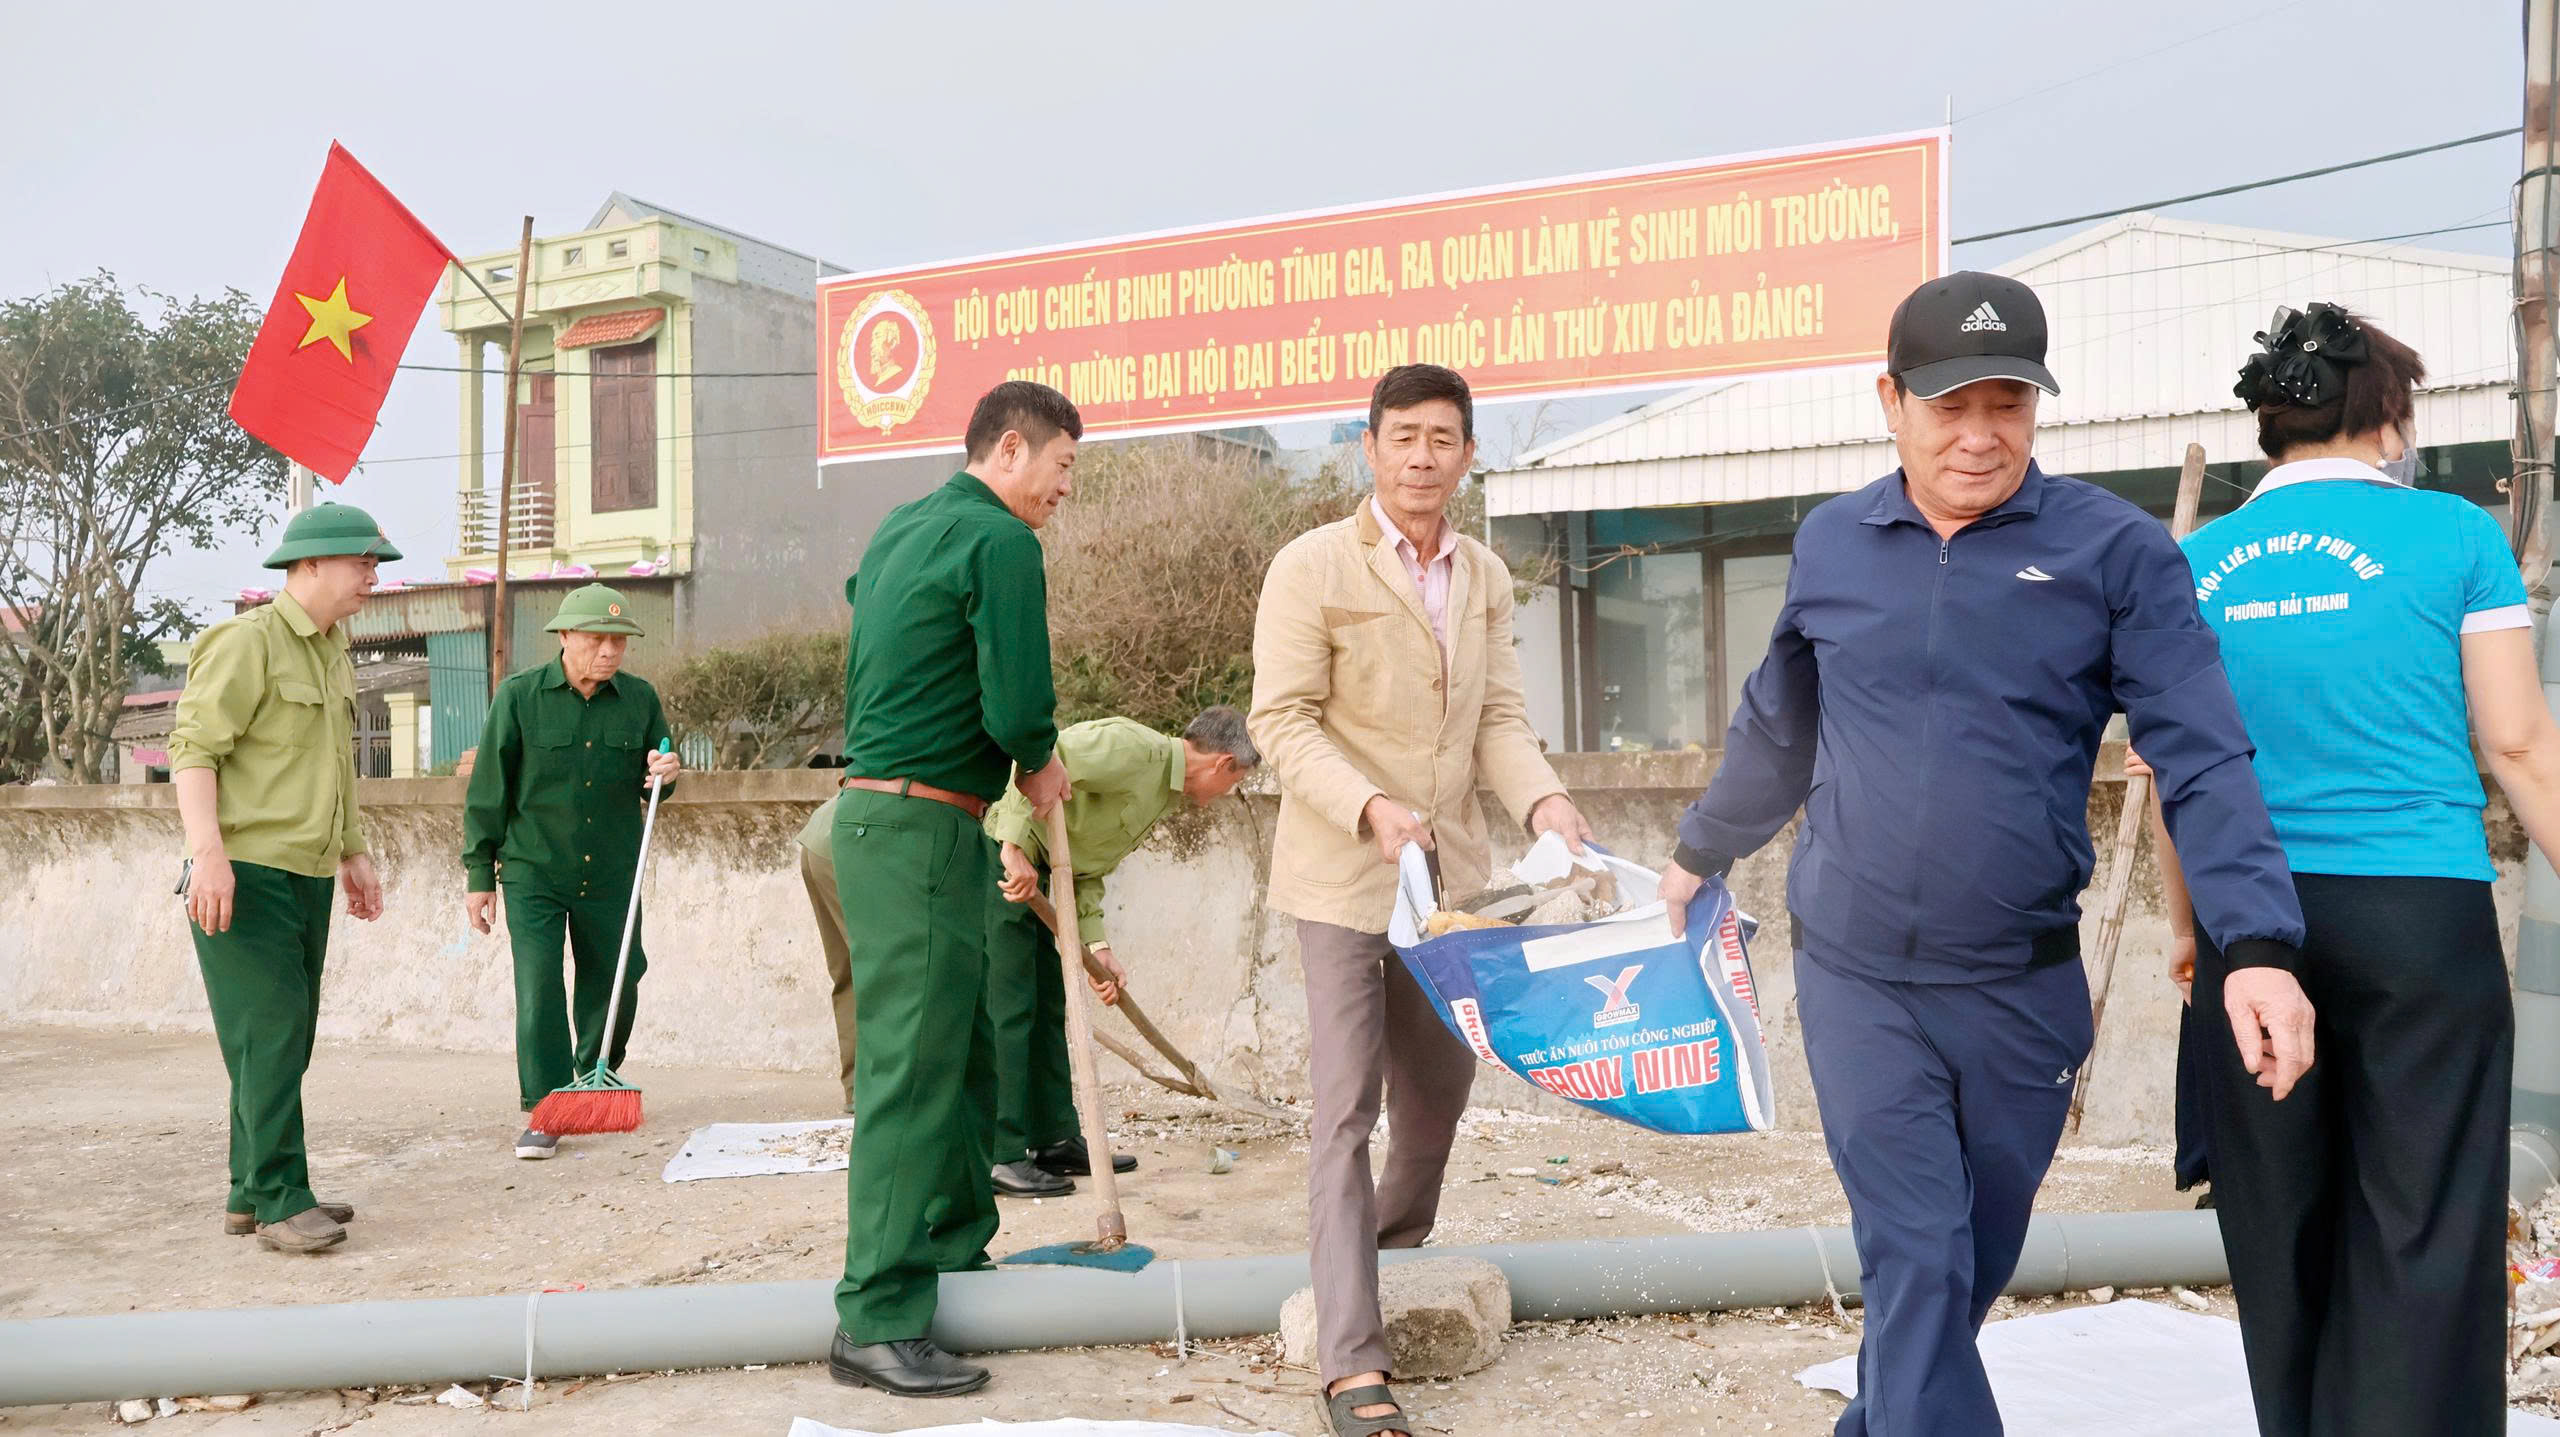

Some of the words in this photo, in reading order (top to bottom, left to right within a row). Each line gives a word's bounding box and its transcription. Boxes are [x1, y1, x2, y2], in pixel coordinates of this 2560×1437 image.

[954, 287, 989, 350] HỘI
[995, 285, 1038, 345] CỰU
[1044, 266, 1111, 330] CHIẾN
[1117, 271, 1172, 323] BINH
[1178, 253, 1275, 317] PHƯỜNG
[1281, 246, 1337, 304] TĨNH
[1344, 245, 1393, 298] GIA,
[1401, 241, 1434, 290] RA
[1442, 223, 1514, 290] QUÂN
[1522, 216, 1579, 276] LÀM
[1587, 208, 1621, 278] VỆ
[1629, 209, 1697, 265] SINH
[1707, 191, 1762, 254] MÔI
[1771, 176, 1900, 248] TRƯỜNG,
[1070, 350, 1137, 407] MỪNG
[1142, 351, 1181, 408] ĐẠI
[1188, 337, 1226, 408] HỘI
[1233, 341, 1275, 400] ĐẠI
[1281, 316, 1336, 386] BIỂU
[1343, 319, 1408, 380] TOÀN
[1416, 303, 1486, 370] QUỐC
[1494, 297, 1545, 364] LẦN
[1553, 295, 1607, 358] THỨ
[1611, 301, 1657, 354] XIV
[1665, 279, 1724, 349] CỦA
[1730, 270, 1824, 344] ĐẢNG!
[1961, 318, 2007, 333] adidas
[2195, 570, 2223, 602] HỘI
[2218, 541, 2262, 574] LIÊN
[2266, 531, 2313, 555] HIỆP
[2224, 600, 2277, 623] PHƯỜNG
[2279, 592, 2302, 616] HẢI
[2304, 592, 2349, 613] THANH
[1518, 1048, 1548, 1065] THỨC
[1550, 1046, 1566, 1062] ĂN
[1568, 1039, 1598, 1058] NUÔI
[1600, 1034, 1629, 1052] TÔM
[1632, 1027, 1668, 1045] CÔNG
[1672, 1017, 1717, 1039] NGHIỆP
[1596, 1005, 1637, 1022] GROWMAX
[1528, 1056, 1625, 1100] GROW
[1633, 1037, 1720, 1095] NINE
